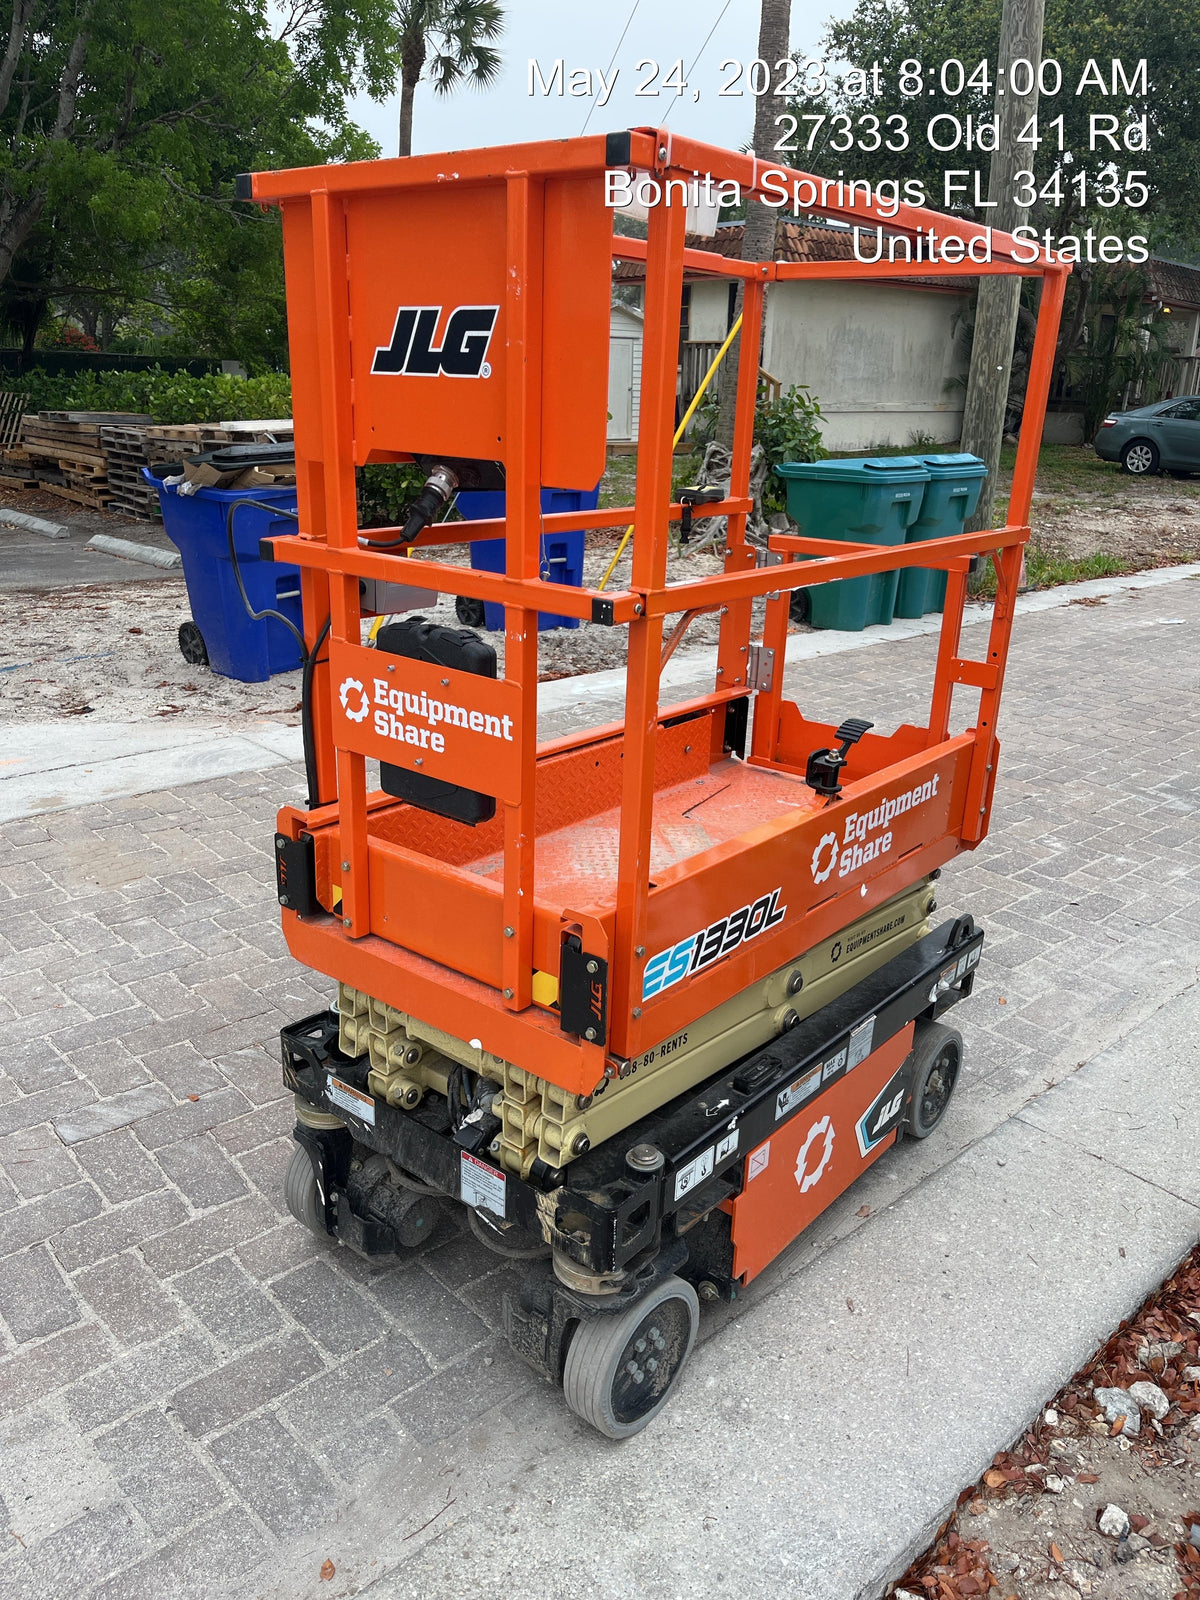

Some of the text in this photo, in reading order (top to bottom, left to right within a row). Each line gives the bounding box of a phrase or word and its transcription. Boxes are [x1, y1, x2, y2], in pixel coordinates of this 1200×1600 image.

[371, 305, 499, 378] JLG
[373, 678, 514, 741] Equipment
[374, 709, 446, 754] Share
[843, 773, 940, 845] Equipment
[838, 831, 893, 878] Share
[642, 887, 787, 1003] ES1330L
[845, 914, 906, 954] EQUIPMENTSHARE.COM
[590, 979, 602, 1021] JLG
[619, 1032, 688, 1080] 8-80-RENTS
[871, 1088, 905, 1135] JLG
